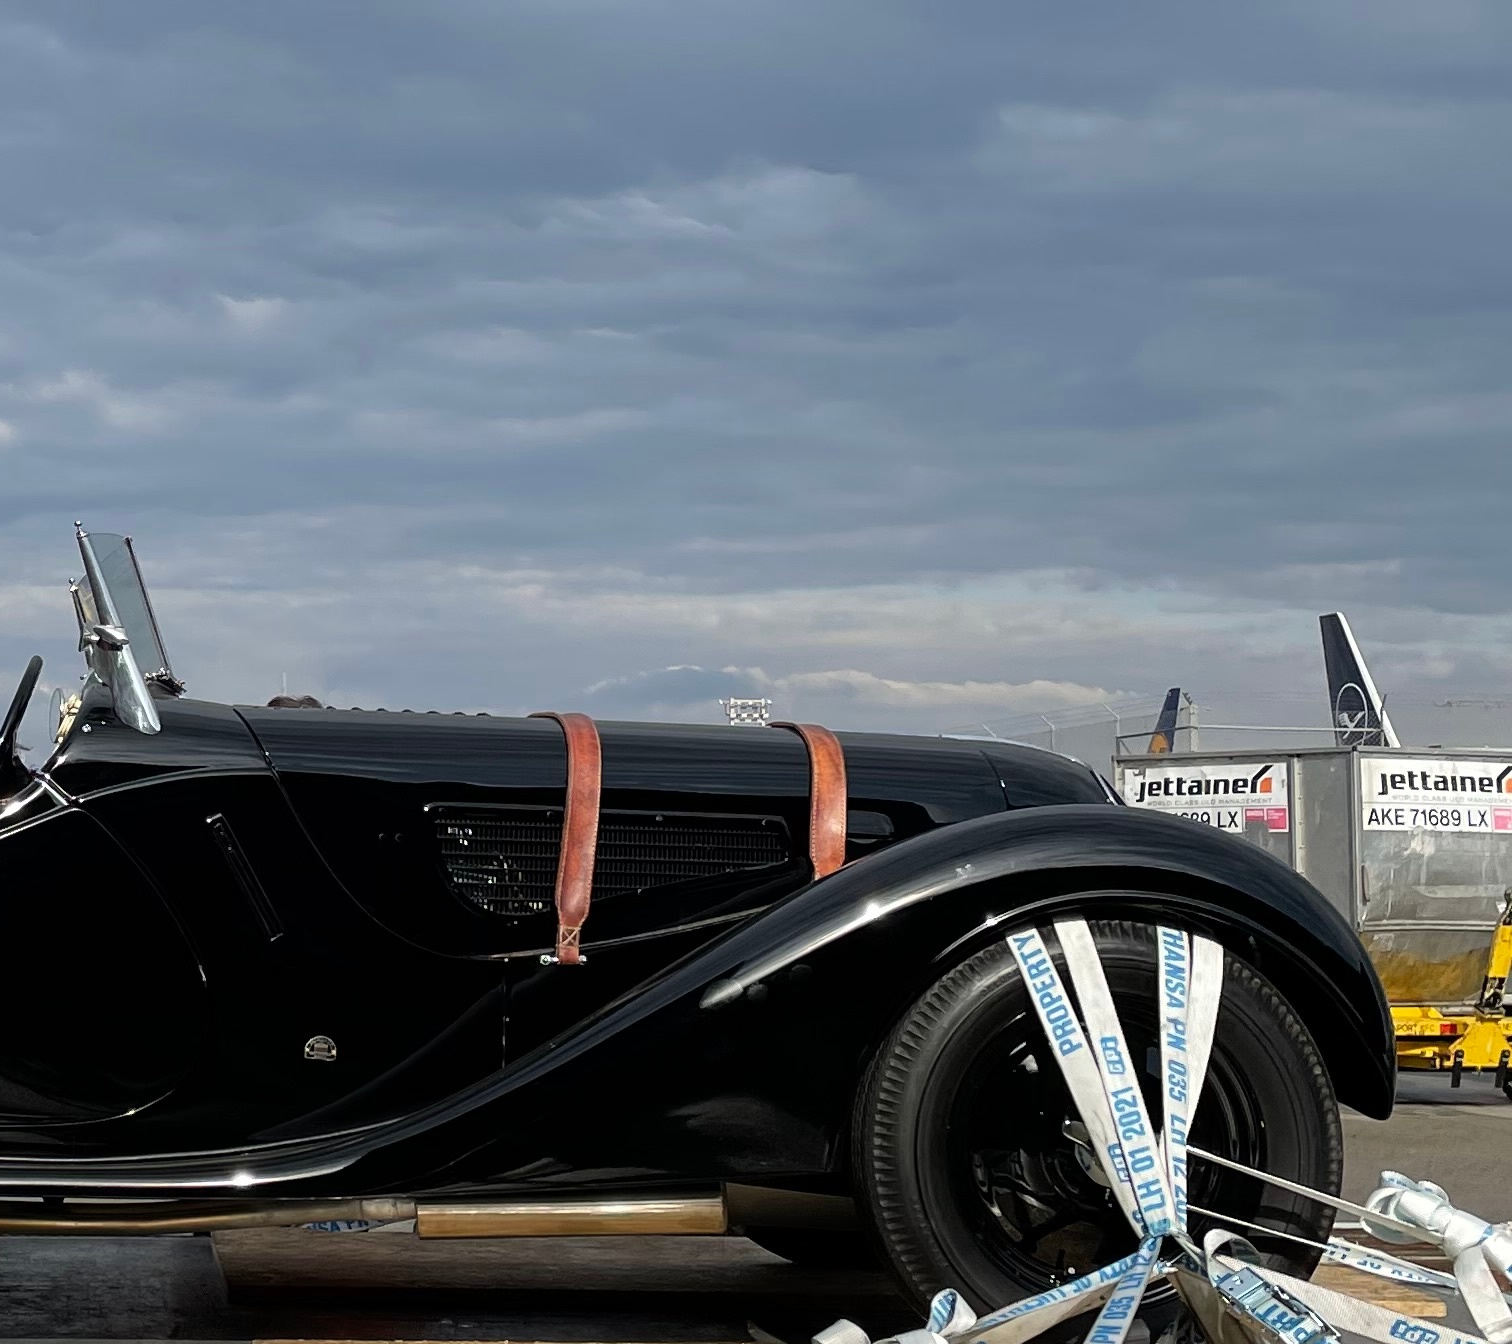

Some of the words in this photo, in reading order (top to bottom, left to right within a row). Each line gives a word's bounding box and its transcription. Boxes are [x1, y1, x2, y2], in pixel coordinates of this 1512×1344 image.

[1136, 764, 1274, 803] jettainer
[1217, 811, 1239, 828] LX
[1368, 808, 1405, 826] AKE
[1410, 808, 1461, 827] 71689
[1467, 810, 1489, 827] LX
[1013, 934, 1083, 1057] PROPERTY
[1166, 1016, 1187, 1052] PN
[1168, 1059, 1187, 1103] 035
[1111, 1086, 1146, 1141] 2021
[1128, 1146, 1155, 1173] 01
[1138, 1178, 1166, 1213] LH
[1103, 1295, 1135, 1320] 035
[1090, 1325, 1122, 1344] PN
